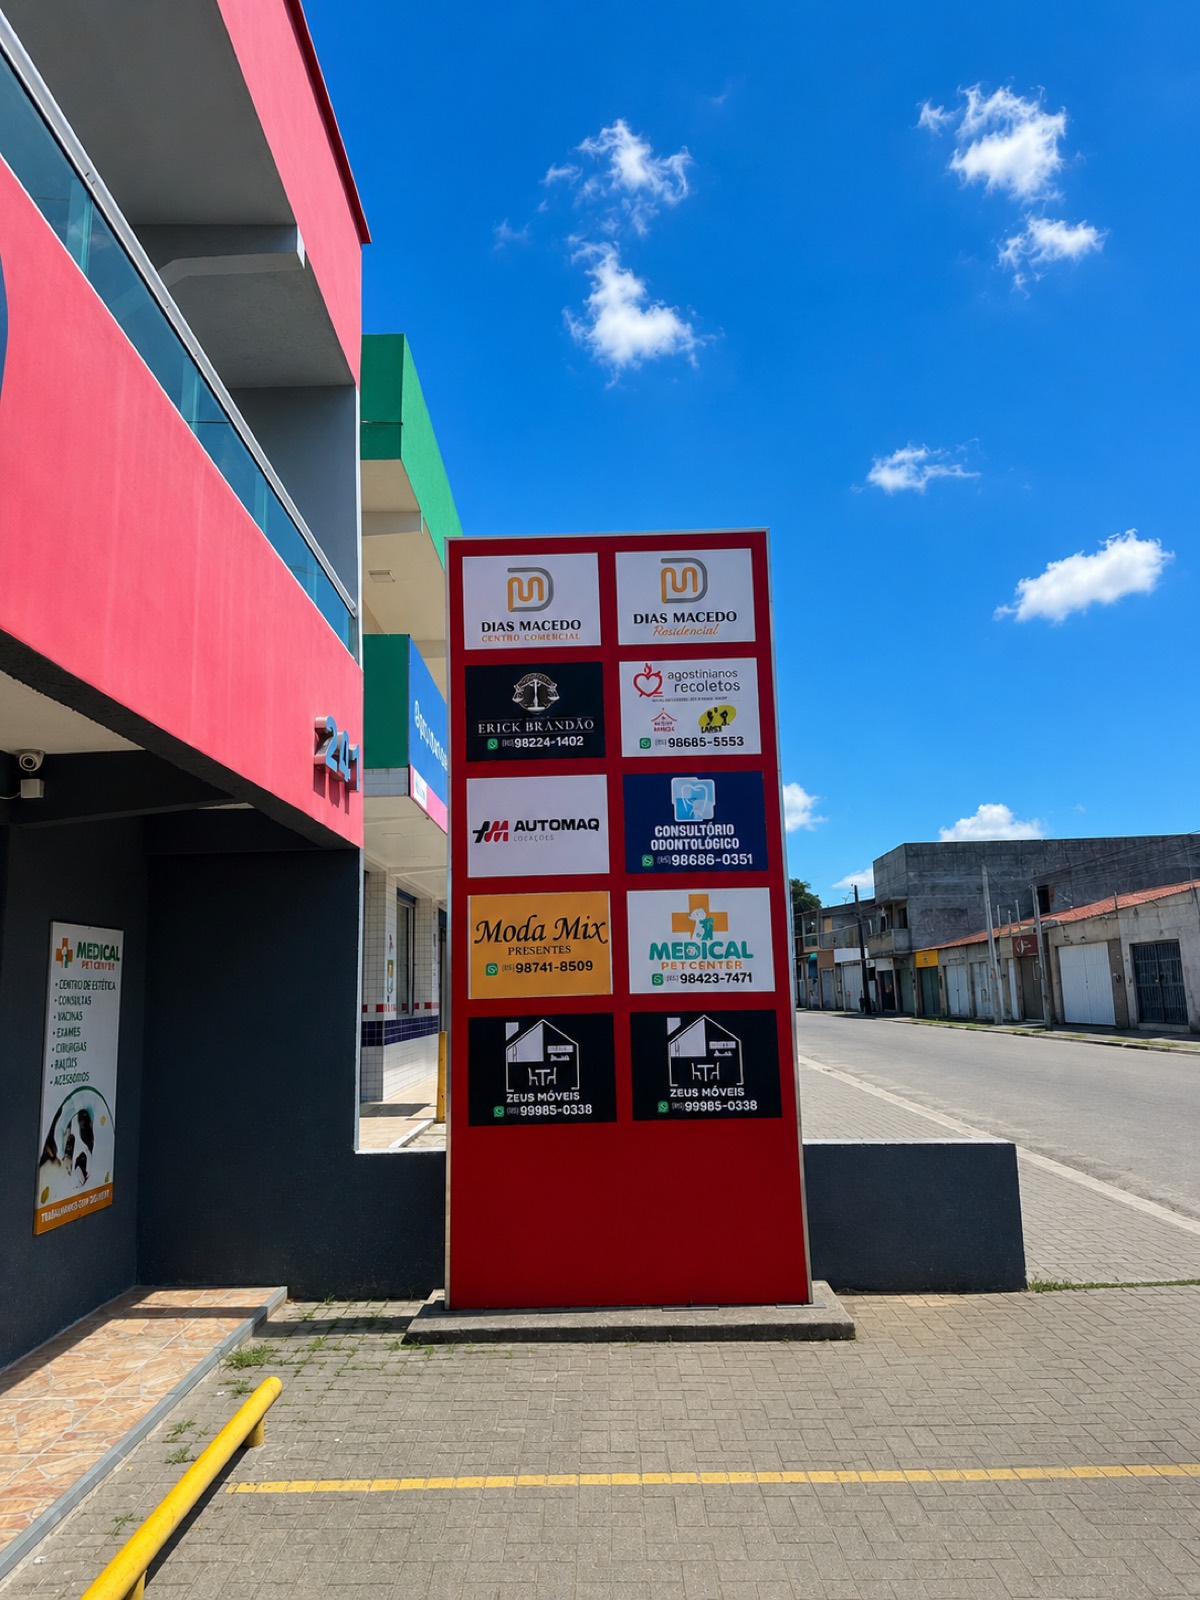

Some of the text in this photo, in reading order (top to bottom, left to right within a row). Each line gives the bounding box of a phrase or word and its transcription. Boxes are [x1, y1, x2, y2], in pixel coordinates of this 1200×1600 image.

[633, 611, 737, 624] DIAS MACEDO
[481, 619, 582, 632] DIAS MACEDO
[481, 632, 581, 642] CENTRO COMERCIAL
[667, 669, 738, 682] agostinianos
[674, 680, 741, 693] recoletos
[478, 718, 594, 734] ERICK BRANDÃO
[513, 818, 600, 832] AUTOMAQ
[654, 822, 735, 837] CONSULTÓRIO
[650, 837, 740, 851] ODONTOLÓGICO
[474, 914, 609, 944] Moda Mix
[76, 941, 120, 961] MEDICAL
[507, 945, 571, 956] PRESENTES
[649, 941, 754, 960] MEDICAL
[506, 1090, 580, 1103] ZEUS MÓVEIS
[670, 1085, 745, 1098] ZEUS MÓVEIS
